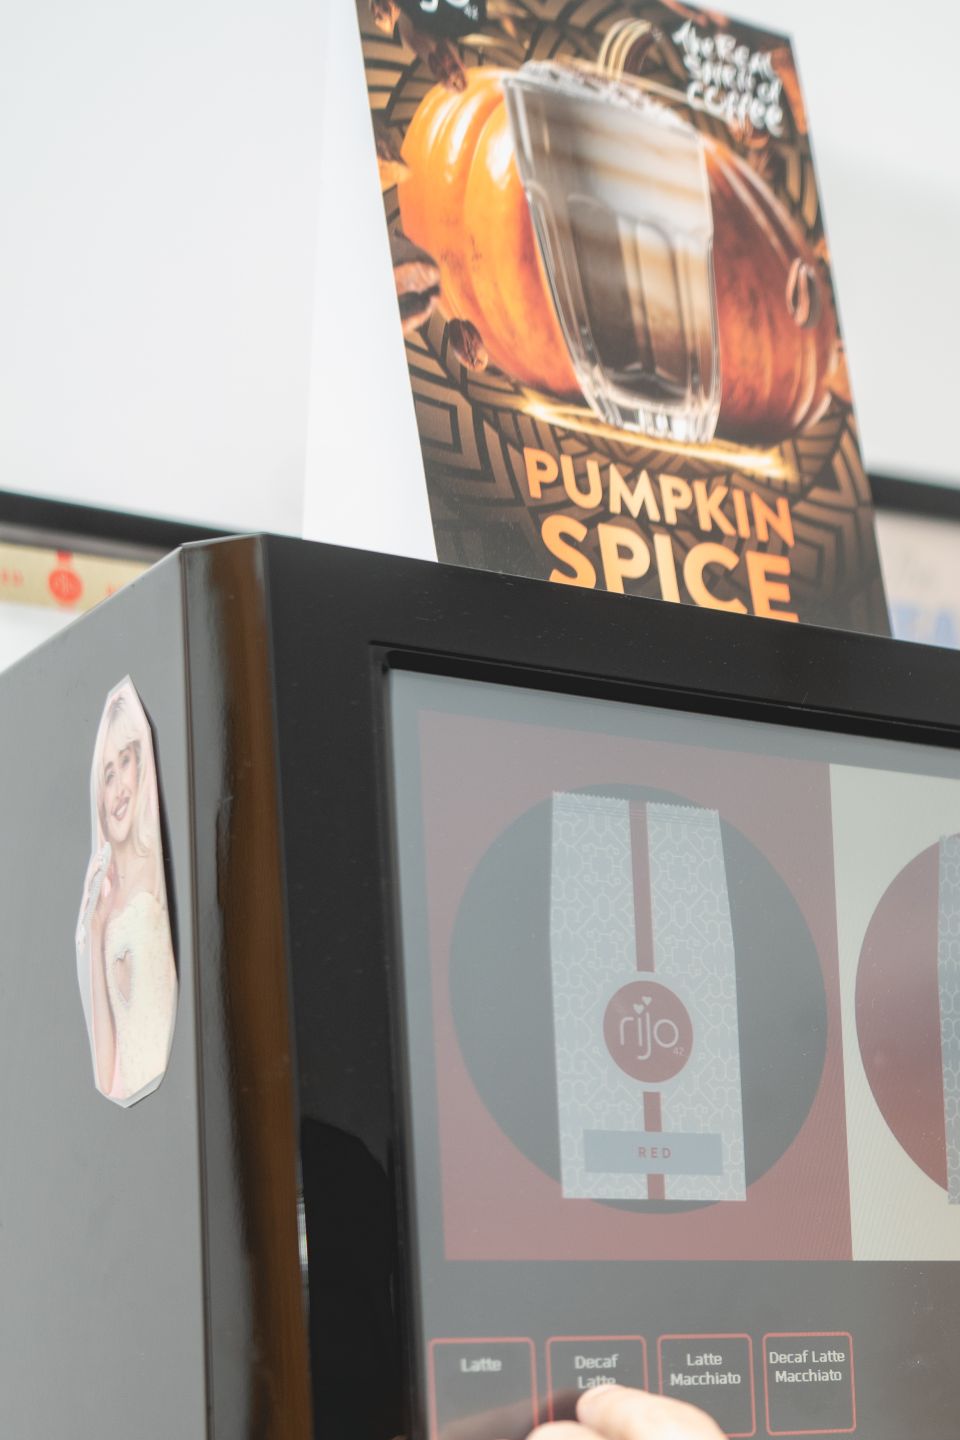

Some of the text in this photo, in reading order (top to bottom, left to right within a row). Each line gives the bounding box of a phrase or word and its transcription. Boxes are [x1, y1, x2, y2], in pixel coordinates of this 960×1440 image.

[523, 446, 796, 549] PUMPKIN
[540, 514, 801, 624] SPICE
[620, 1012, 679, 1061] rijo
[637, 1146, 671, 1159] RED
[574, 1354, 619, 1369] Decaf
[687, 1353, 723, 1367] Latte
[769, 1350, 846, 1364] Decaf Latte
[460, 1358, 502, 1373] Latte
[670, 1372, 741, 1387] Macchiato
[775, 1368, 842, 1383] Macchiato
